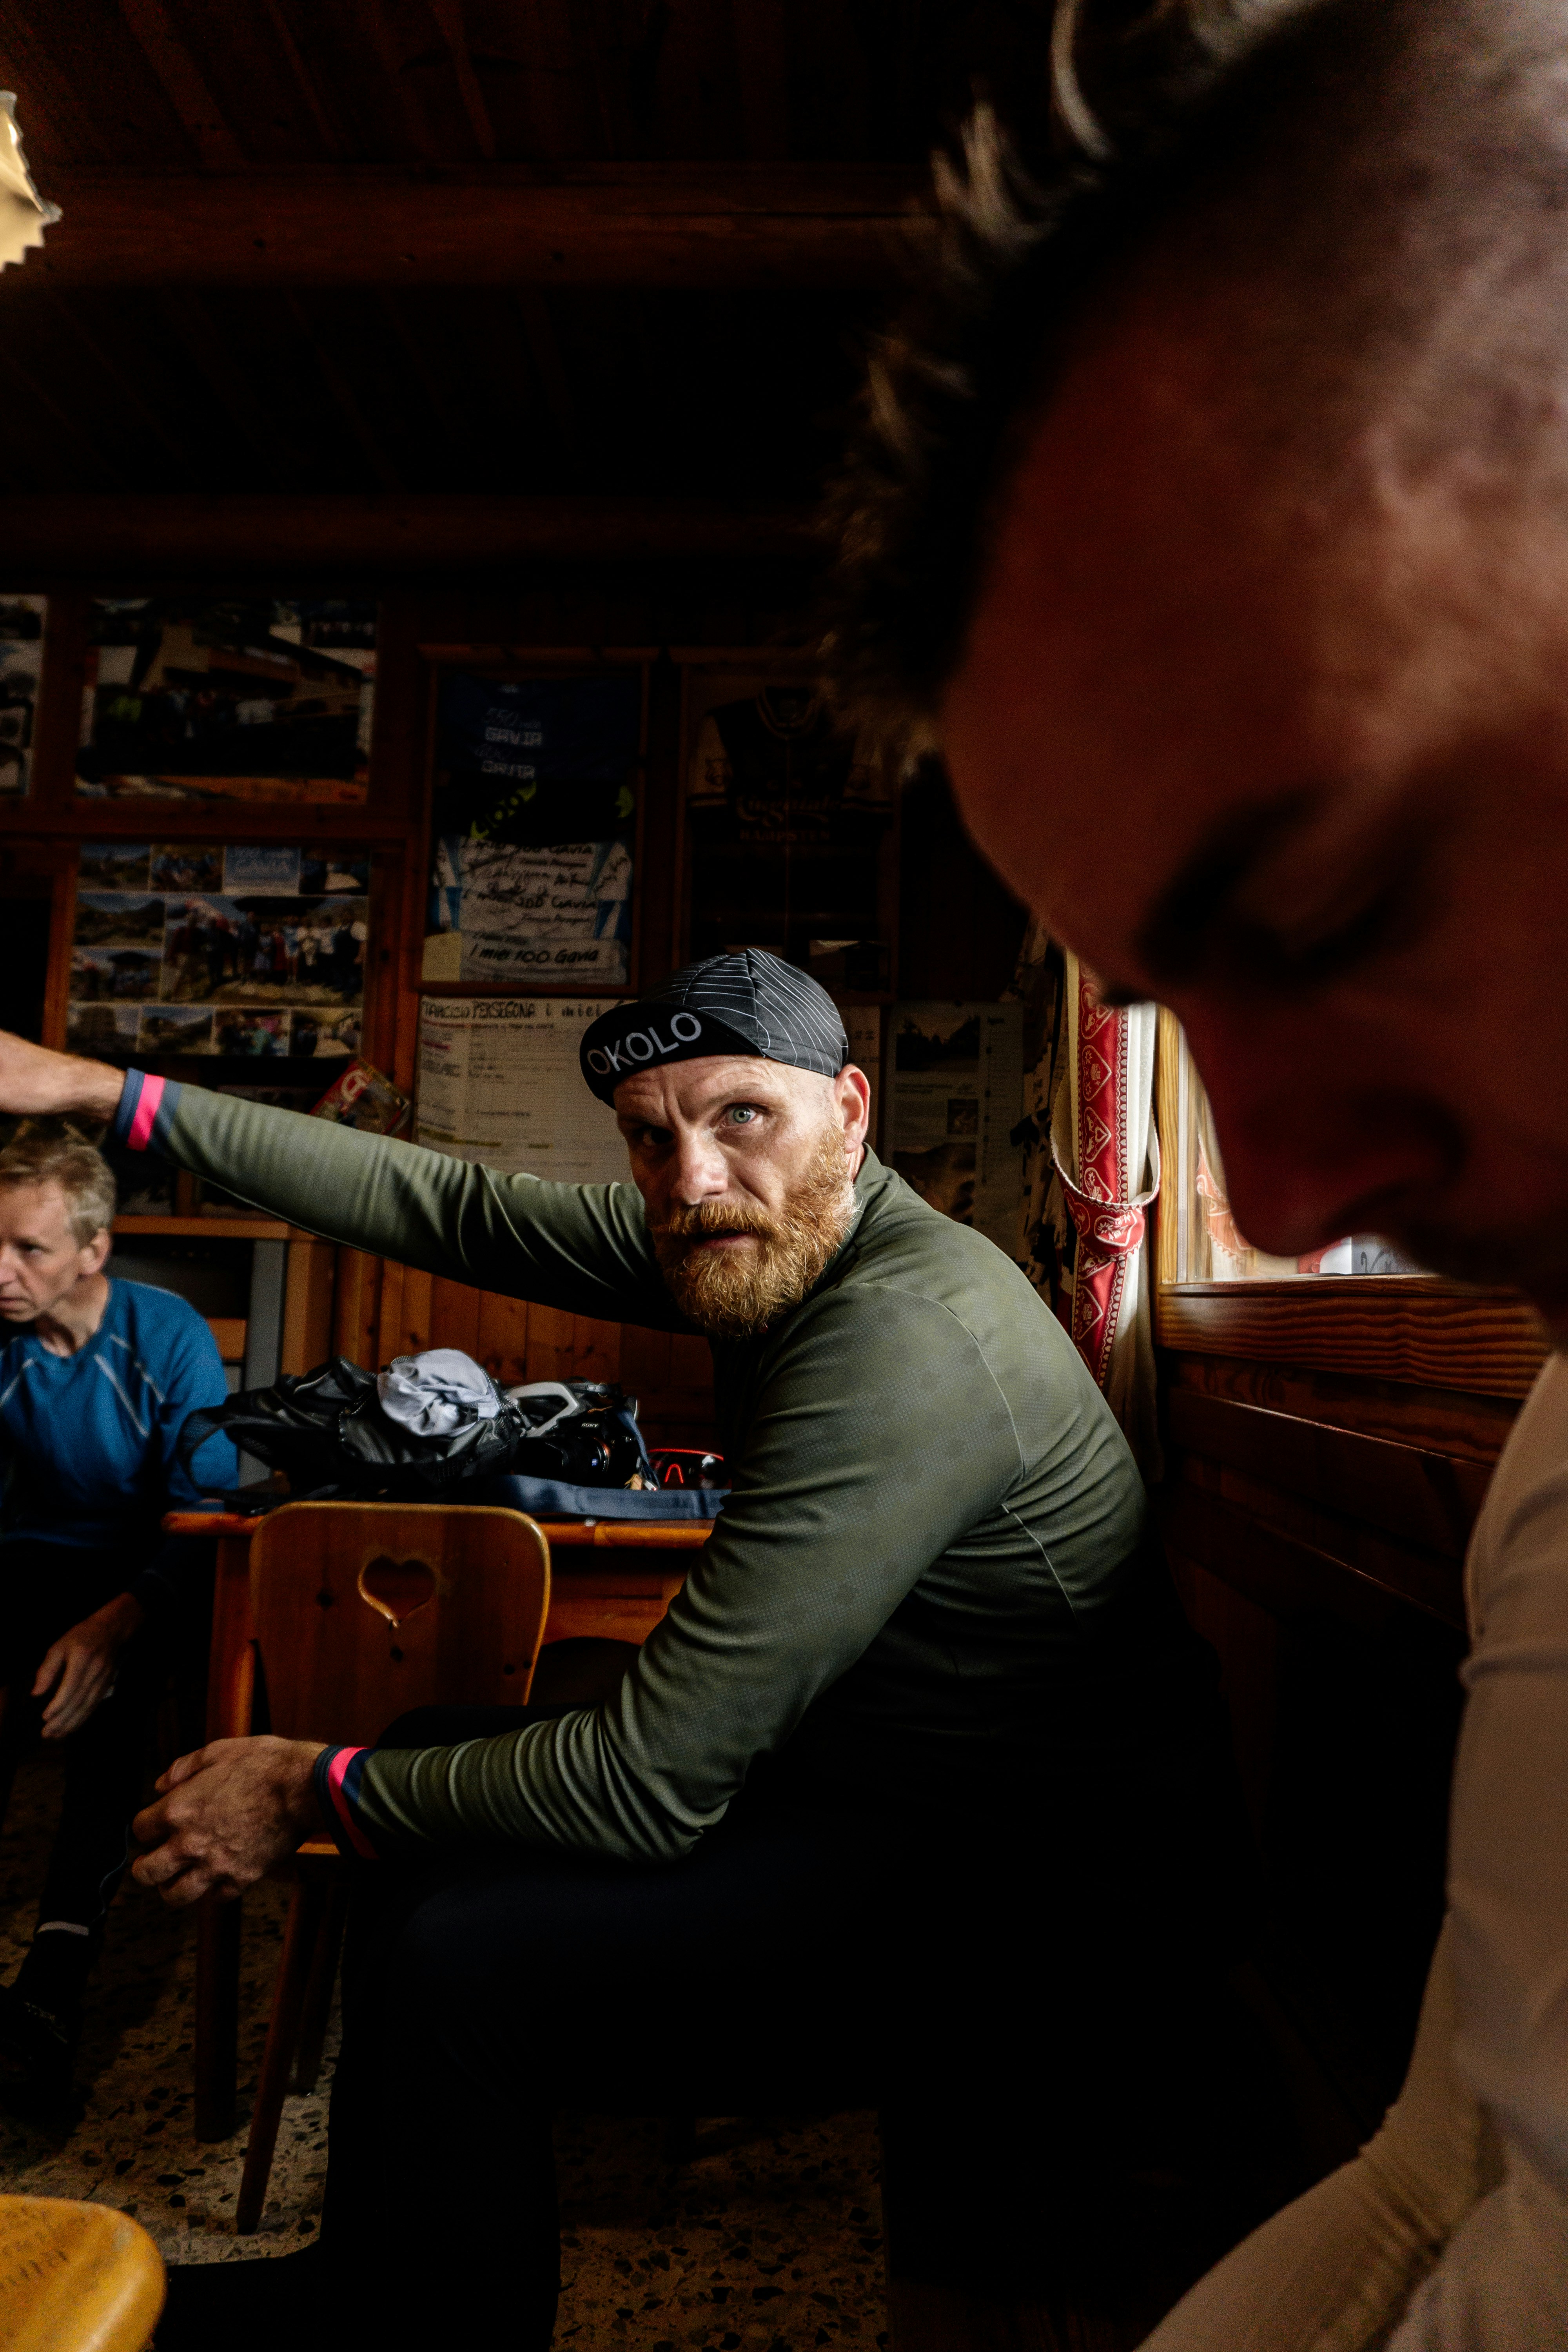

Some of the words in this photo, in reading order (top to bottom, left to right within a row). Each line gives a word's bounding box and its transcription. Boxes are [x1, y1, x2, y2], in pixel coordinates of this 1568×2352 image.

[485, 726, 543, 746] GAVIA
[552, 896, 597, 909] GAVIA
[515, 949, 550, 963] 100
[555, 948, 599, 964] Gavia
[471, 1000, 535, 1019] PERSEGONA
[587, 1012, 702, 1075] OKOLO
